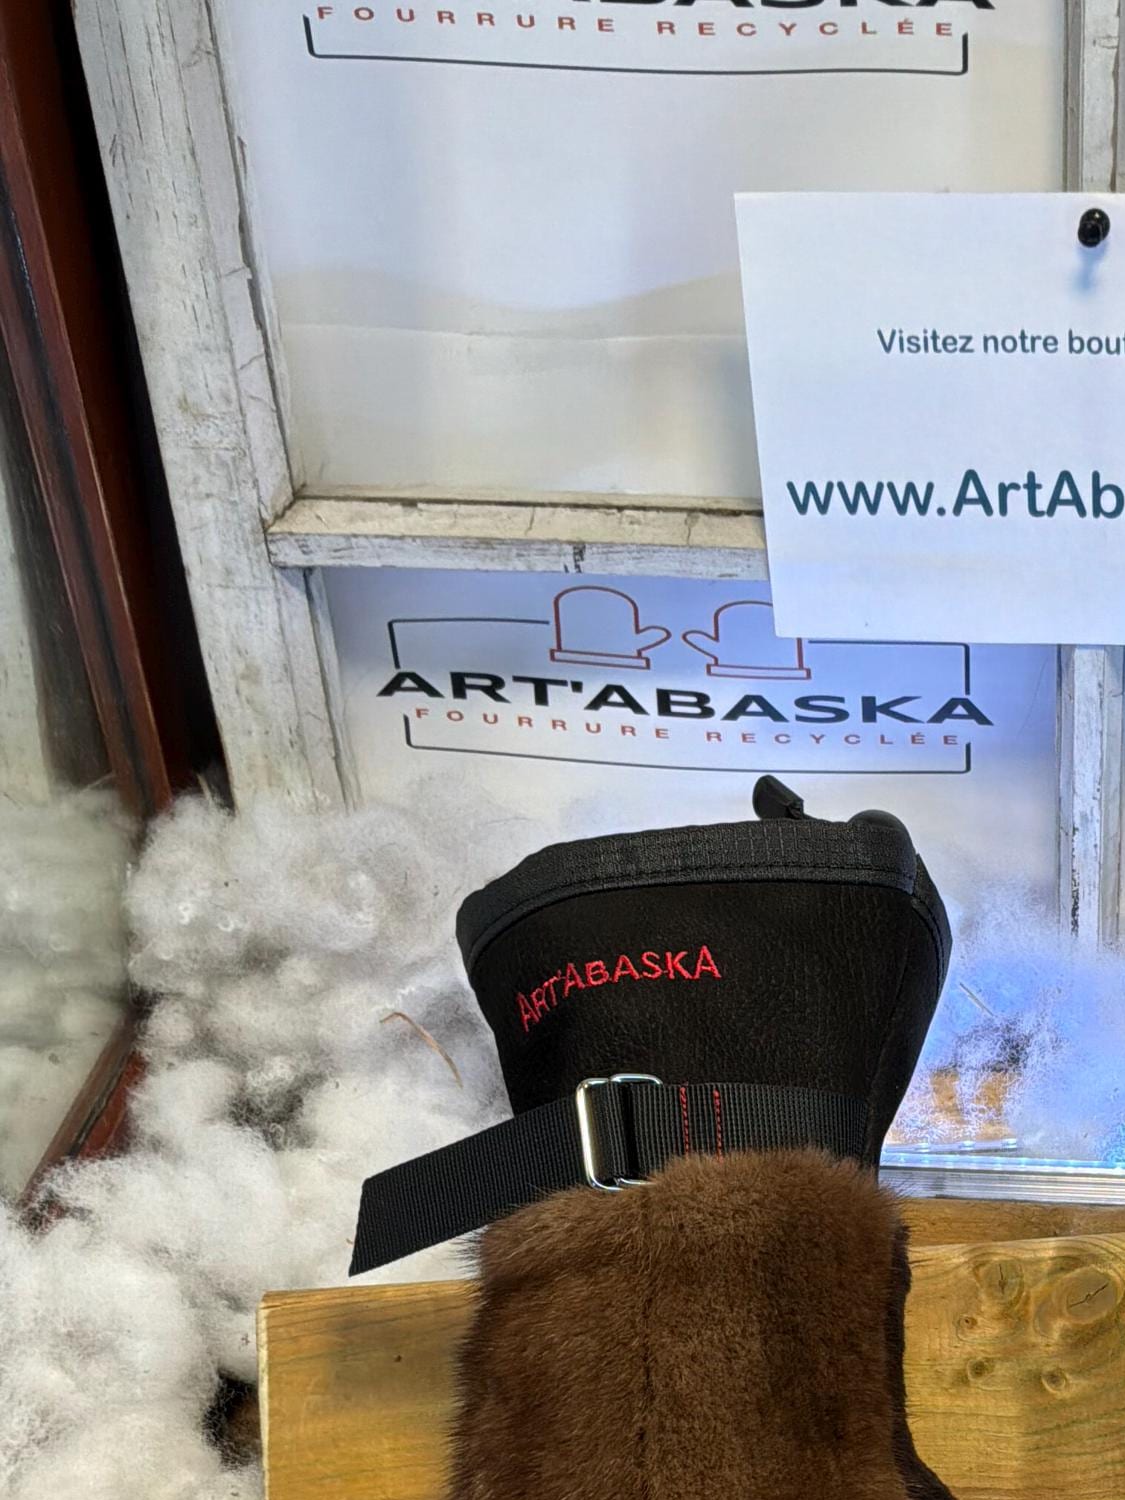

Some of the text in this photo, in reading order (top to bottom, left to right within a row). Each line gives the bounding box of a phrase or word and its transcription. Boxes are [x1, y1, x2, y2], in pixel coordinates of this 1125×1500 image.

[317, 6, 954, 37] FOURRURE RECYCLÉE
[877, 328, 975, 354] Visitez
[982, 333, 1059, 355] notre
[376, 670, 995, 726] ART'ABASKA
[415, 707, 959, 746] FOURRURE RECYCLÉE
